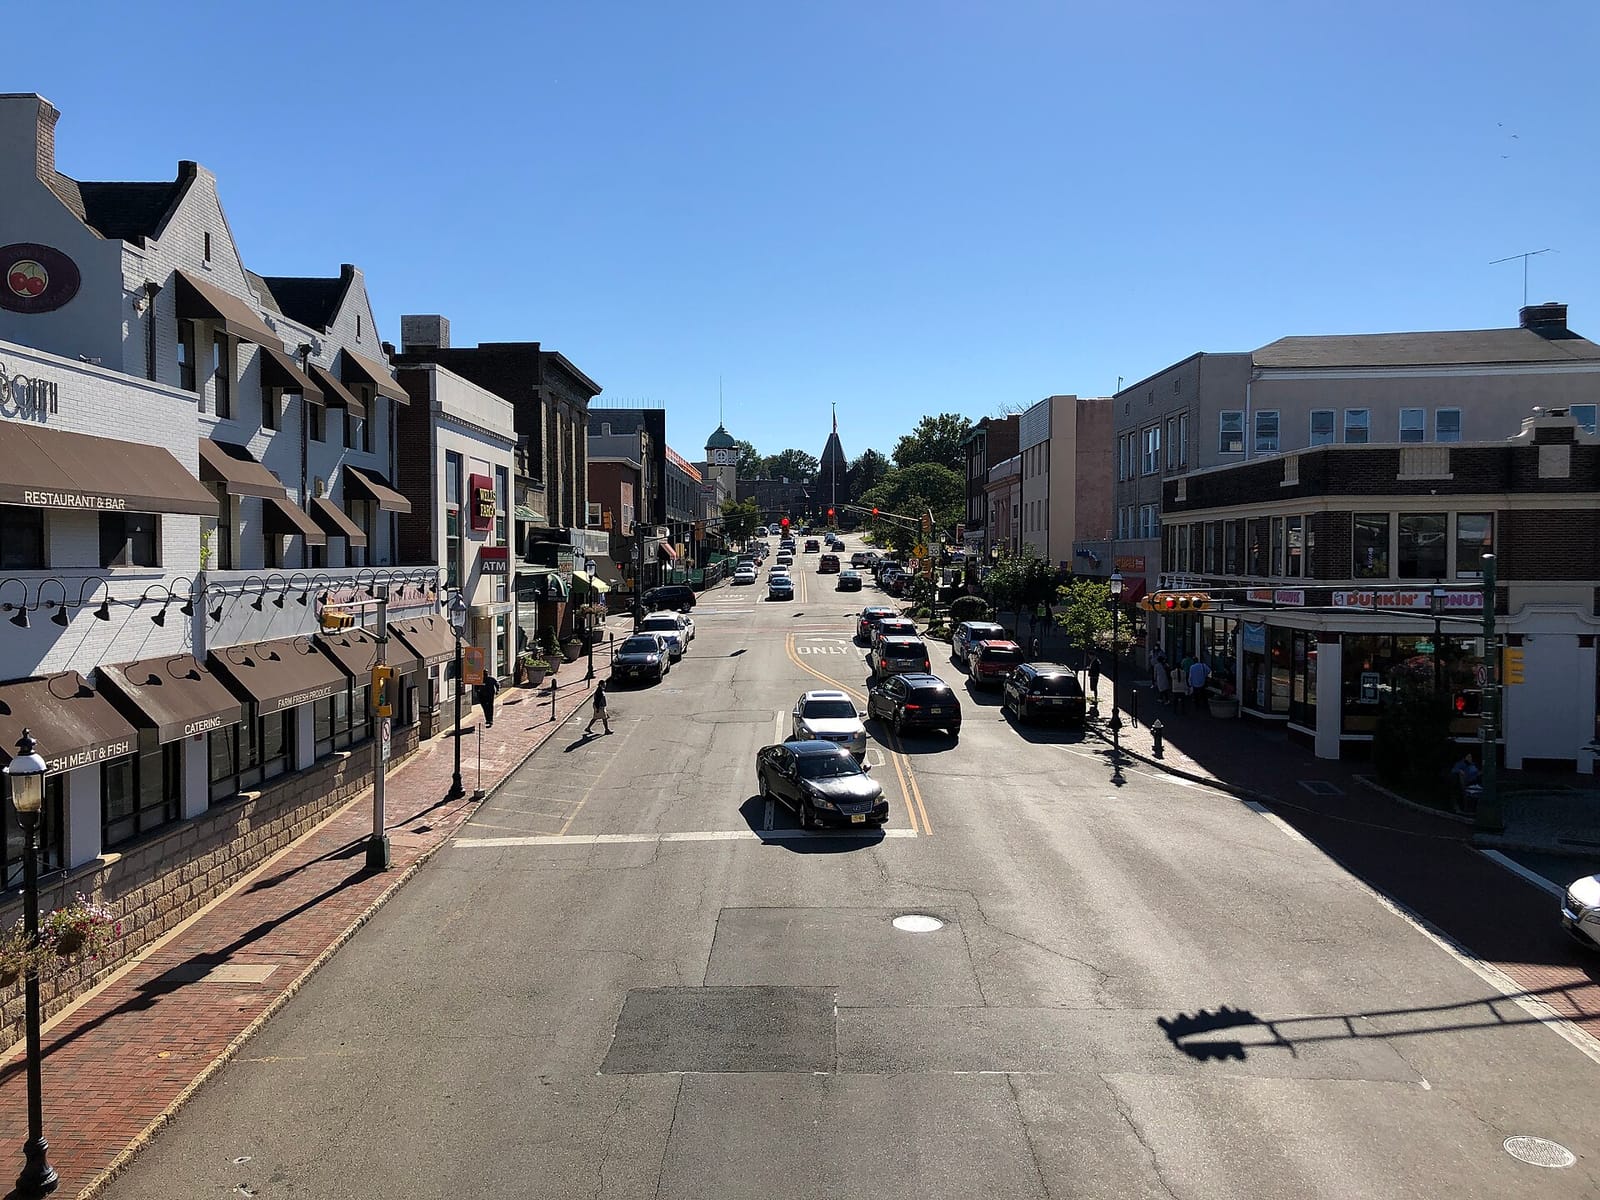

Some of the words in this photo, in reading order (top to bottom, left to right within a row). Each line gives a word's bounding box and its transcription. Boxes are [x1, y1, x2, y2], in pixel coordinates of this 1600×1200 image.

[24, 491, 95, 508] RESTAURANT
[97, 497, 105, 508] &
[105, 498, 125, 509] BAR
[482, 561, 506, 571] ATM
[1346, 593, 1418, 606] DUNKIN'
[796, 646, 848, 655] ONLY
[277, 697, 293, 708] FARM
[292, 693, 309, 704] FRESH
[309, 686, 332, 700] PRODUCE
[184, 716, 221, 735] CATERING
[69, 749, 97, 767] MEAT
[98, 747, 106, 759] &
[107, 741, 129, 757] FISH
